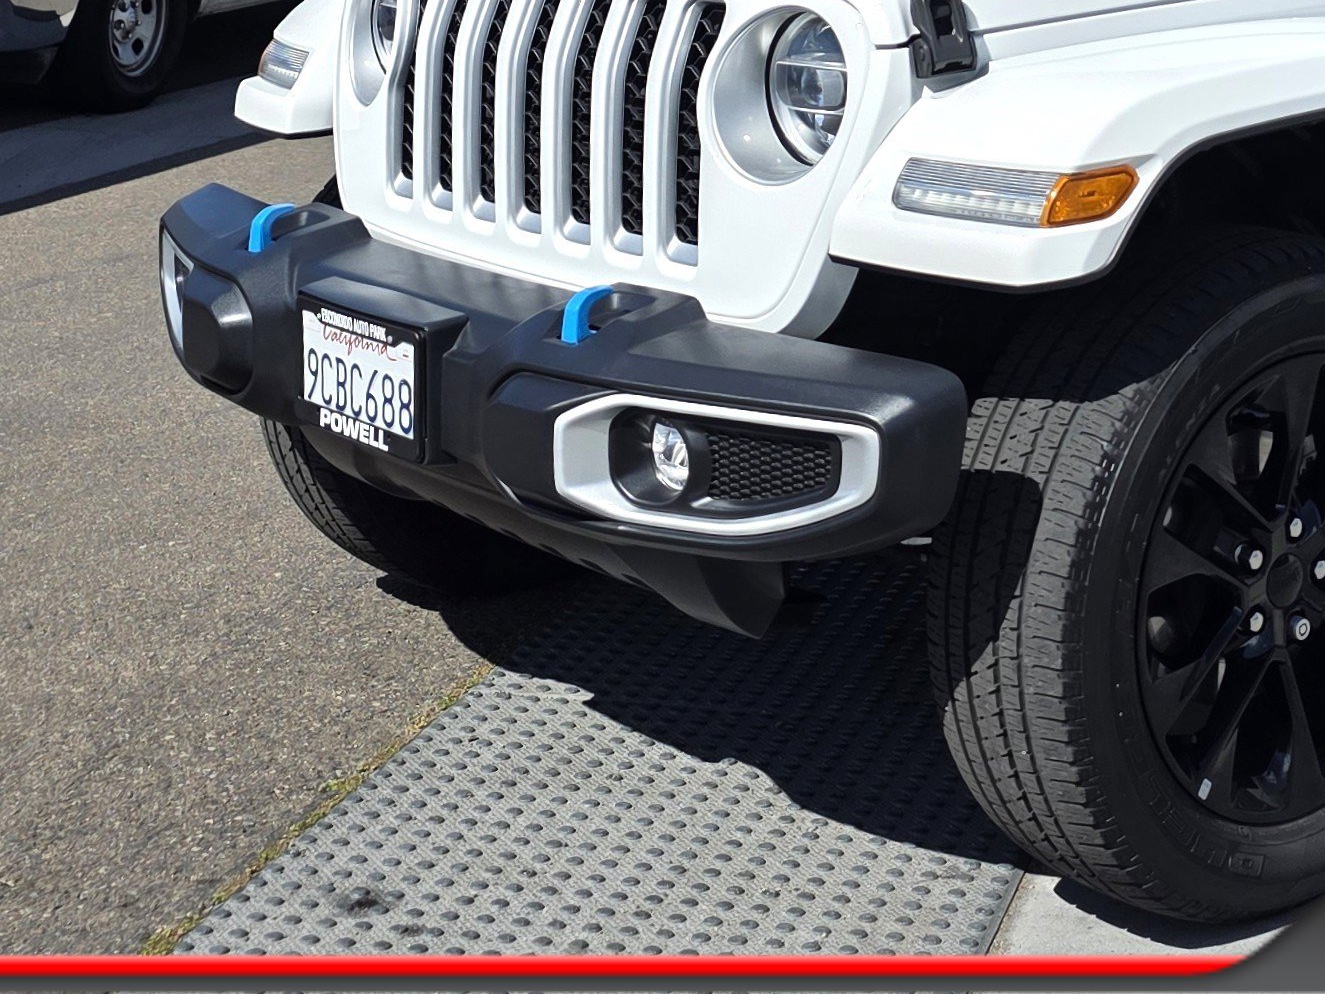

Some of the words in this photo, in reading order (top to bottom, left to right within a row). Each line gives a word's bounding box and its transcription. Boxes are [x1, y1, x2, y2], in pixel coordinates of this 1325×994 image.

[354, 318, 369, 336] AUTO
[370, 323, 387, 342] PARK
[308, 347, 412, 434] 9CBC688
[320, 407, 388, 452] POWELL
